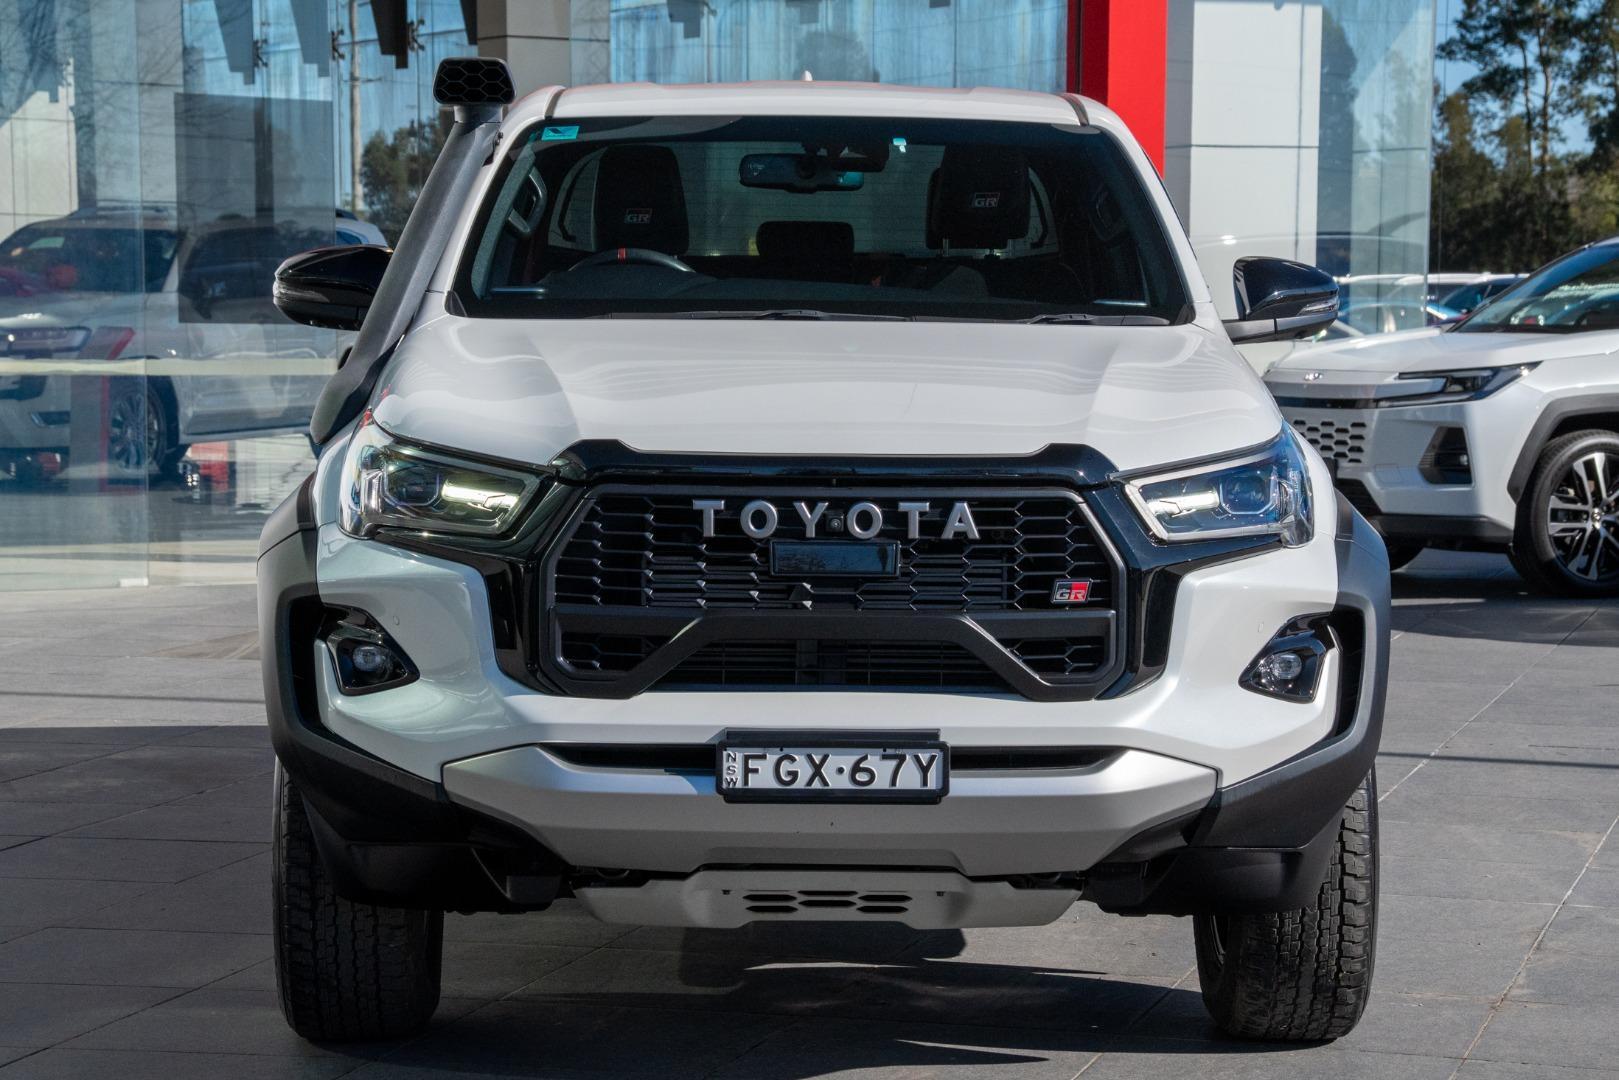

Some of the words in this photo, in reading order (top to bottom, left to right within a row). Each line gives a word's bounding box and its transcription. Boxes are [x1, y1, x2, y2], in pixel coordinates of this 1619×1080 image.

[973, 197, 999, 208] GR
[624, 213, 650, 224] GR
[692, 499, 980, 540] TOYOTA
[1055, 588, 1086, 600] GR
[724, 751, 738, 788] NSW
